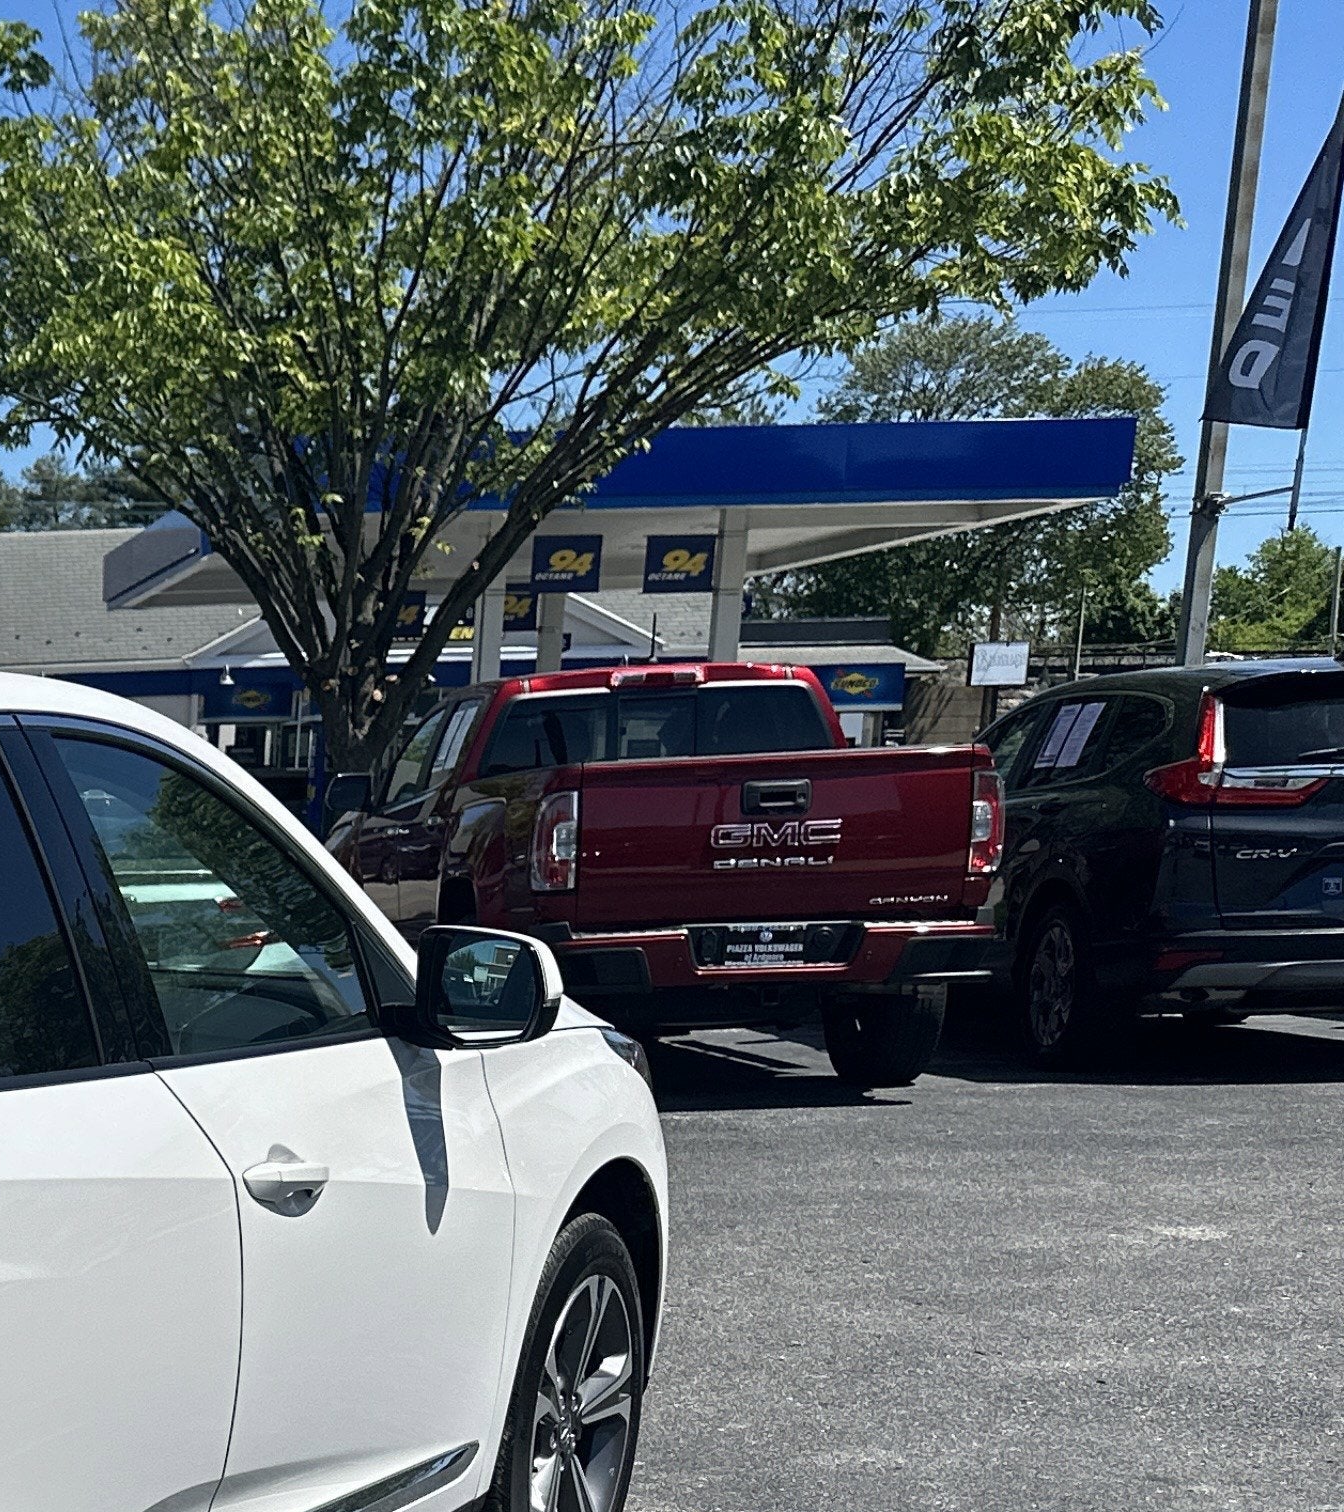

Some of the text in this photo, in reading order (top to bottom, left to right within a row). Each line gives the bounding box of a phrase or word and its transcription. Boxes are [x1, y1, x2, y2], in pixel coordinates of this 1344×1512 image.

[549, 549, 594, 576] 94
[662, 549, 708, 576] 94
[711, 818, 843, 848] GMC
[713, 855, 834, 870] DENALI
[1236, 848, 1297, 859] CR-V
